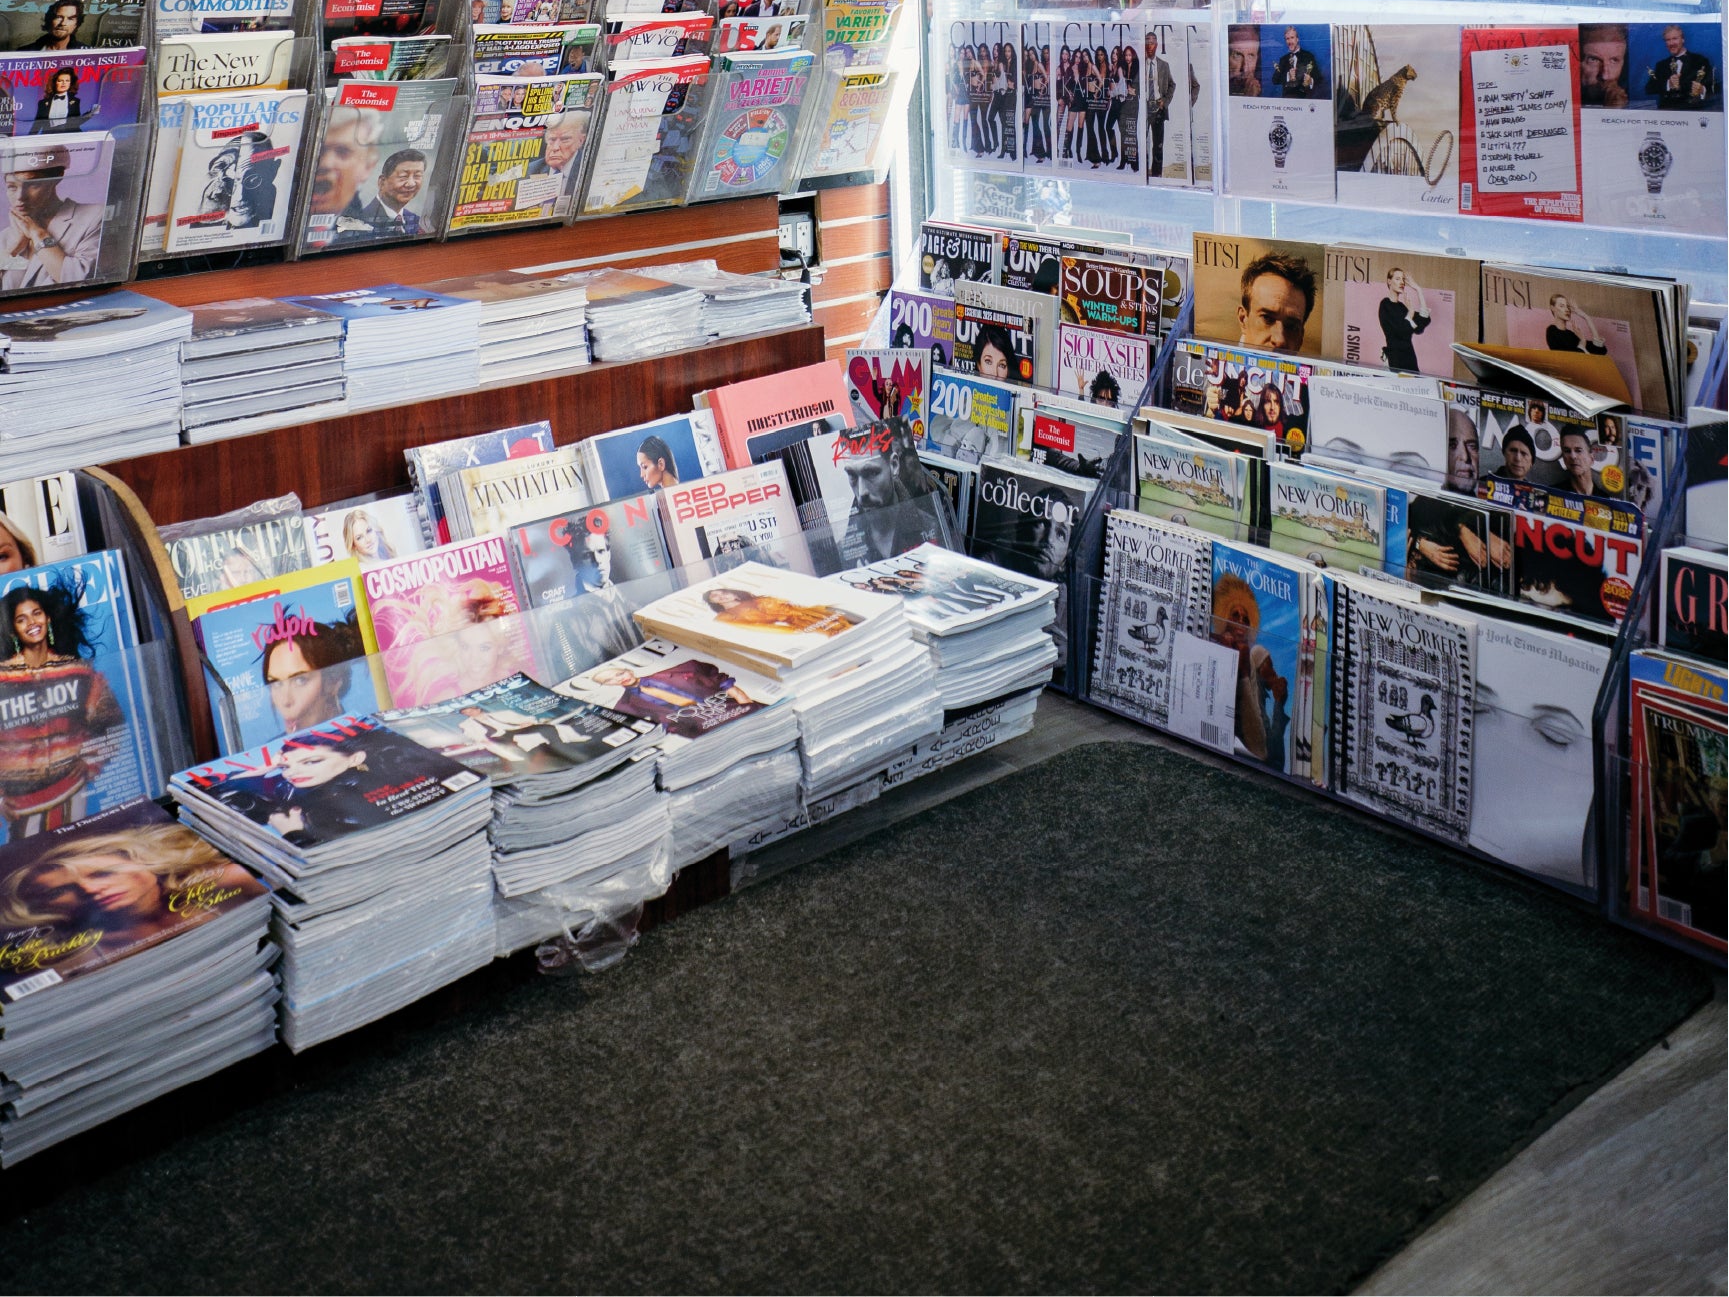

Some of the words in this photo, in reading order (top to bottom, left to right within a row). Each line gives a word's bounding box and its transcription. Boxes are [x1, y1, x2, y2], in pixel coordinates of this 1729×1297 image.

[331, 3, 376, 13] Economist
[837, 15, 889, 28] VARIETY
[8, 60, 58, 70] LEGENDS
[98, 56, 127, 65] ISSUE
[340, 56, 384, 67] Economist
[355, 50, 371, 58] The
[162, 71, 258, 91] Criterion
[757, 68, 787, 78] FAMILY
[361, 90, 377, 98] The
[729, 74, 808, 101] VARIETY
[194, 101, 279, 117] POPULAR
[345, 96, 390, 106] Economist
[191, 112, 298, 130] MECHANICS
[1527, 127, 1568, 139] DERANGED
[466, 142, 482, 163] $1
[488, 139, 542, 162] TRILLION
[459, 184, 481, 204] THE
[482, 180, 517, 200] DEVIL
[1421, 191, 1454, 204] Cartier
[922, 232, 945, 256] PAGE
[946, 238, 960, 258] &
[962, 240, 992, 263] PLANT
[1194, 240, 1240, 270] HTSI
[1063, 266, 1160, 306] SOUPS
[1081, 298, 1118, 314] WINTER
[1087, 308, 1138, 328] WARM-UPS
[1063, 332, 1145, 370] SIOUXSIE
[849, 355, 922, 388] GLAM
[930, 380, 972, 421] 200
[972, 388, 998, 403] Greatest
[1320, 386, 1335, 398] The
[1335, 390, 1352, 402] New
[1352, 393, 1373, 410] York
[1374, 397, 1398, 411] Times
[1398, 400, 1438, 418] Magazine
[1481, 393, 1500, 404] JEFF
[1502, 396, 1525, 408] BECK
[972, 400, 1007, 420] Progressive
[1549, 407, 1568, 417] DAVID
[832, 426, 895, 467] Rocks
[1143, 451, 1171, 471] NEW
[1174, 456, 1225, 486] YORKER
[672, 483, 726, 508] RED
[1313, 481, 1331, 492] THE
[676, 483, 781, 524] PEPPER
[982, 477, 1080, 526] collector
[1277, 483, 1310, 503] NEW
[1312, 489, 1371, 521] YORKER
[518, 496, 648, 557] ICON
[366, 537, 506, 597] COSMOPOLITAN
[251, 602, 318, 652] ralph
[1355, 607, 1395, 632] NEW
[1398, 622, 1461, 659] YORKER
[1484, 628, 1513, 648] York
[1514, 635, 1547, 659] Times
[1548, 648, 1601, 676] Magazine
[1664, 661, 1723, 701] LIGHTS
[0, 691, 38, 719] THE
[41, 679, 79, 712] JOY
[1650, 709, 1727, 749] TRUMP'S
[55, 823, 74, 835] The
[75, 811, 119, 829] Directors
[119, 796, 145, 812] Issue
